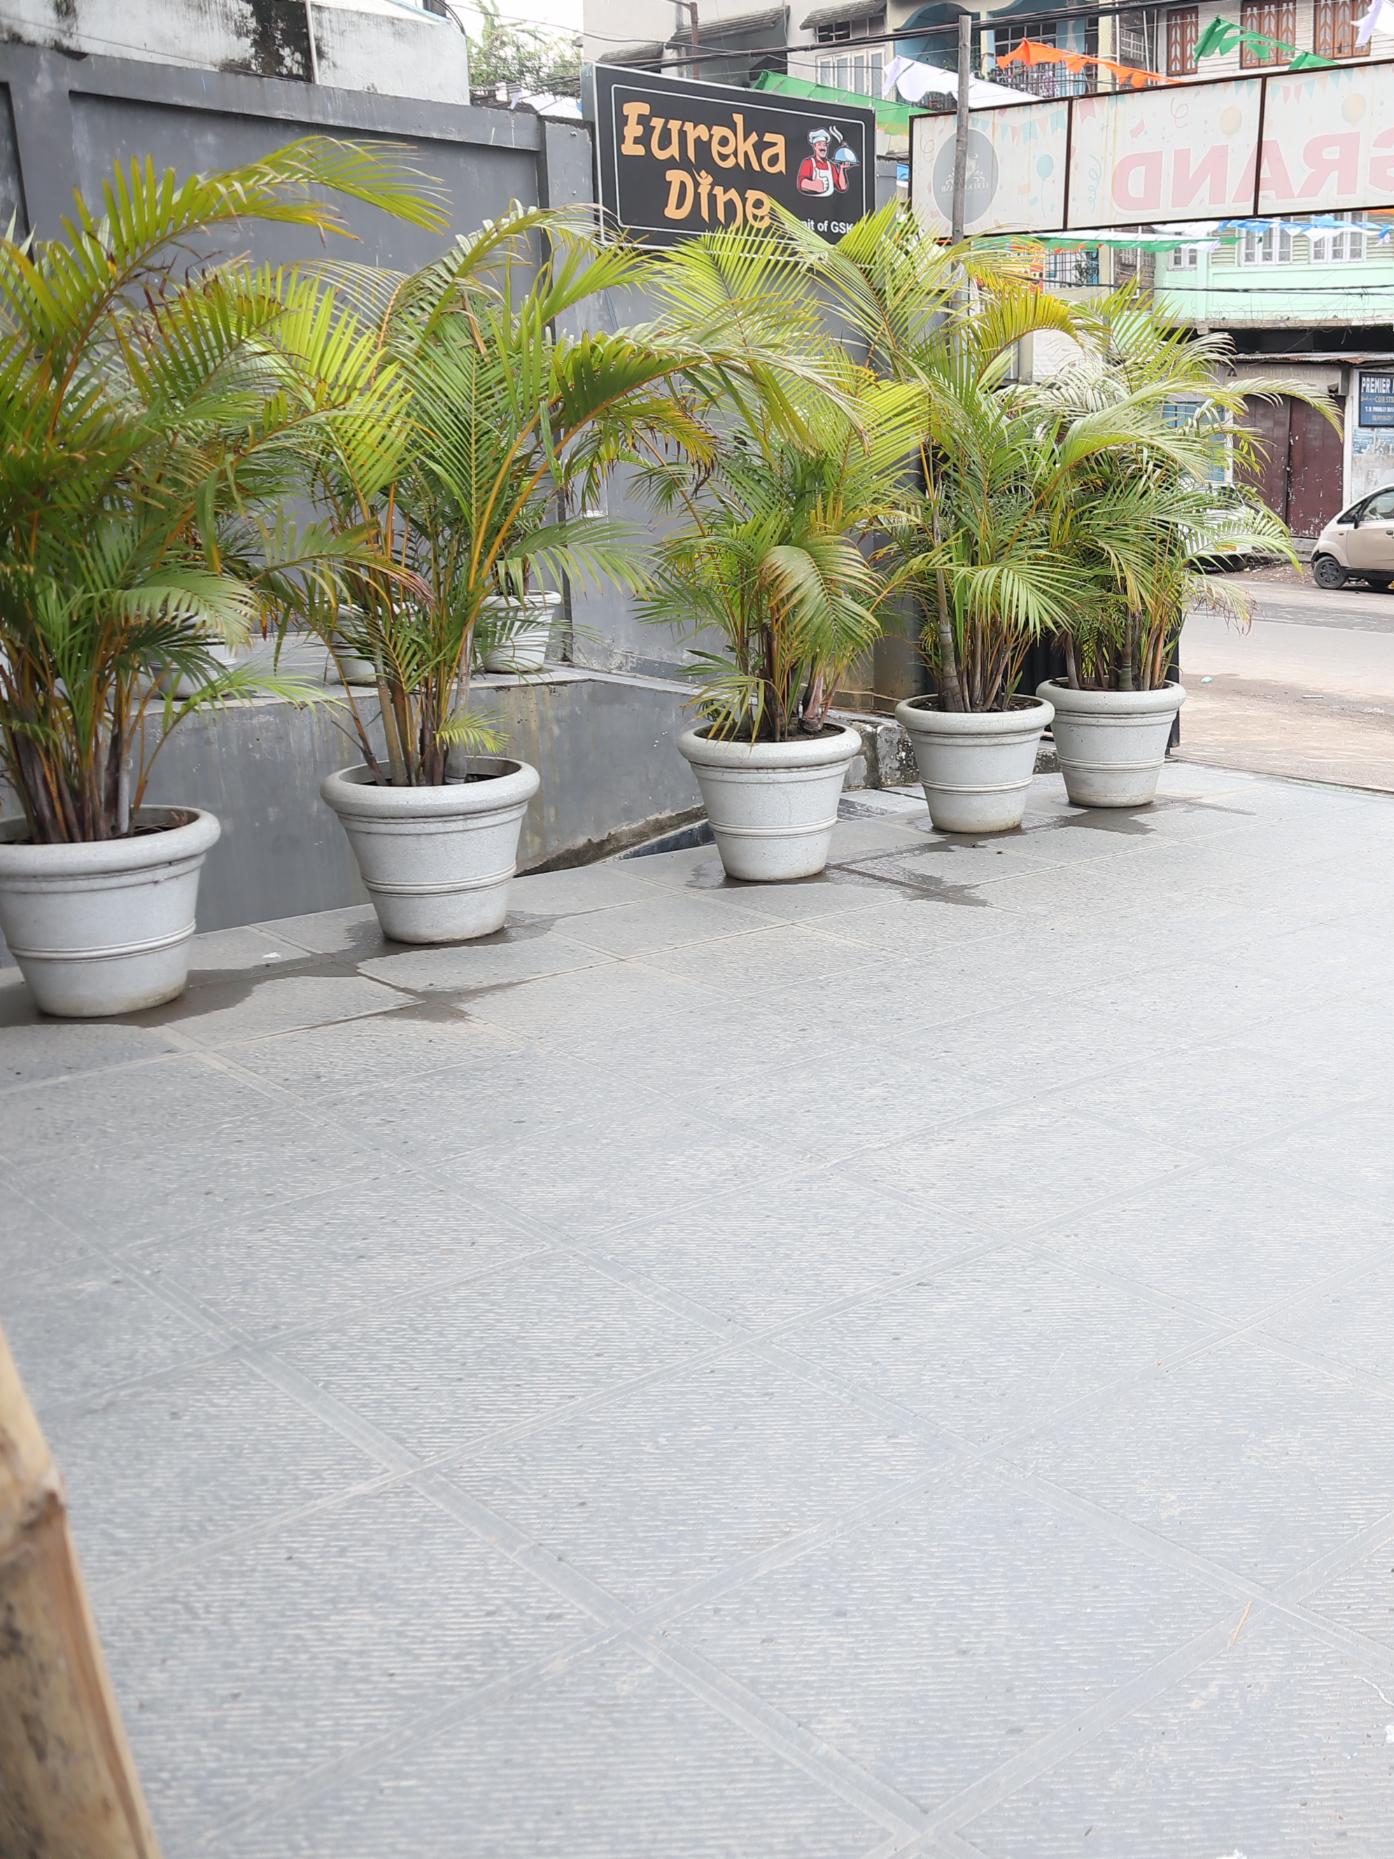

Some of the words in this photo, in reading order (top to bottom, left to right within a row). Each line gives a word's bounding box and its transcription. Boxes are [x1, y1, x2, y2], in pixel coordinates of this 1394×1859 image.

[620, 101, 786, 175] Eureka
[664, 168, 772, 230] Dine
[817, 219, 828, 232] of
[1361, 376, 1391, 393] PREMIER
